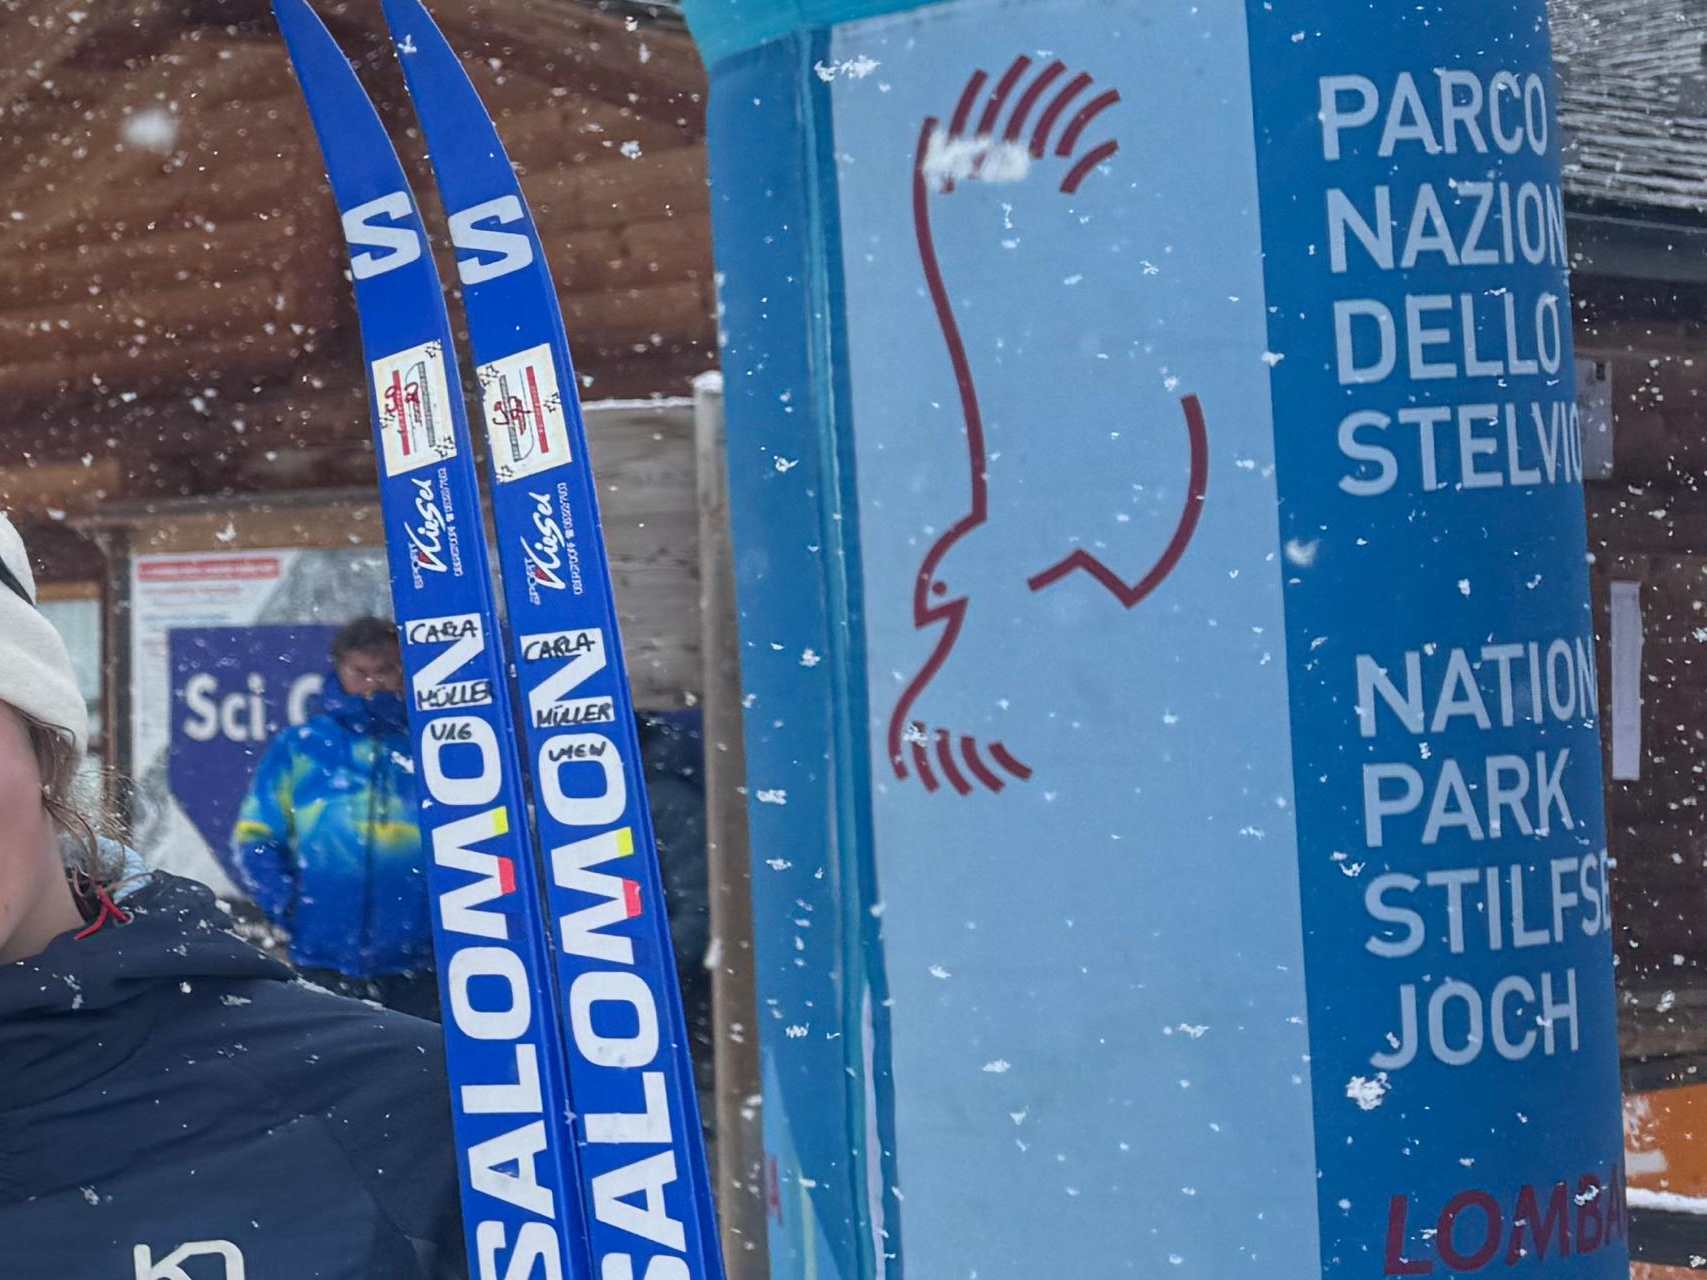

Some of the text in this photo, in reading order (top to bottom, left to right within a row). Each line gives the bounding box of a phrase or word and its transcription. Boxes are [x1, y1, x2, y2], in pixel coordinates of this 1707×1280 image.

[1319, 70, 1547, 161] PARCO
[1333, 292, 1560, 385] DELLO
[1337, 402, 1584, 496] STELVIO
[186, 673, 265, 742] Sci
[1363, 748, 1574, 847] PARK
[1370, 968, 1578, 1071] JOCH
